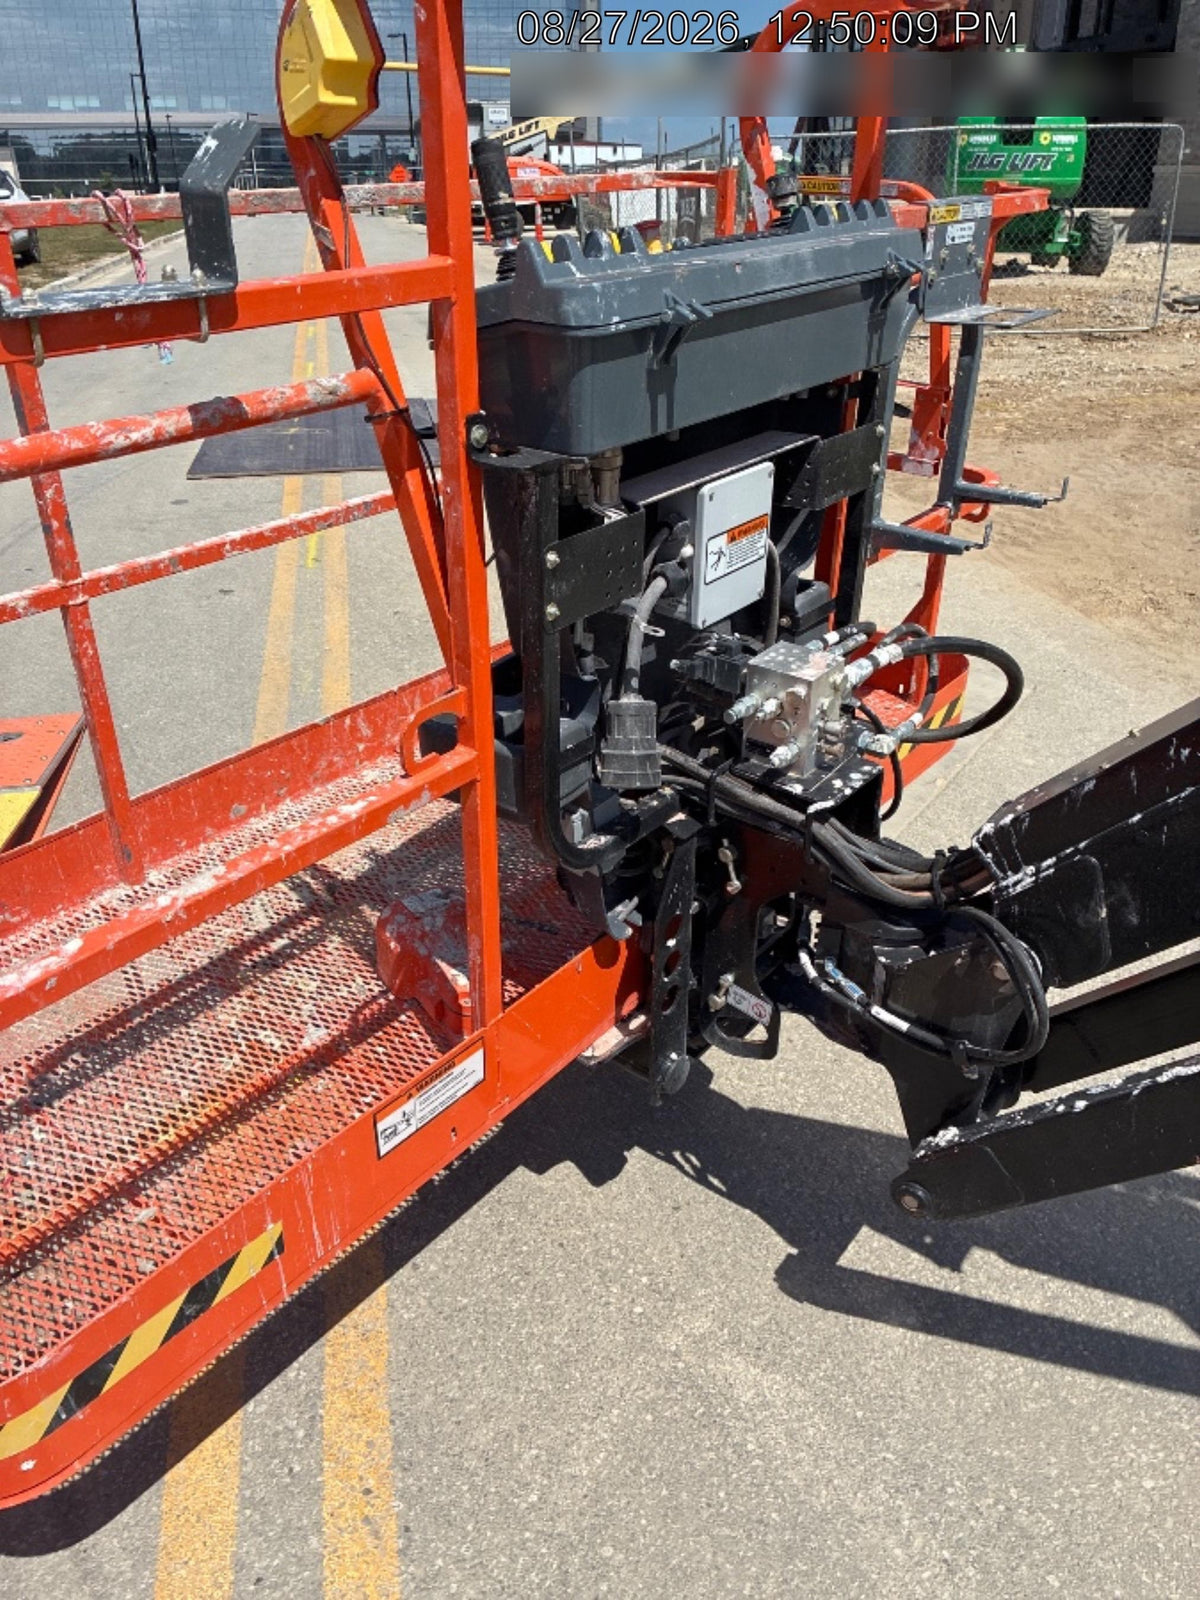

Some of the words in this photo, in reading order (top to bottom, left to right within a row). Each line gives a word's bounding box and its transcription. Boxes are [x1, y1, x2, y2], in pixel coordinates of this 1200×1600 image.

[518, 120, 540, 136] LIFT
[966, 152, 1008, 171] JLG
[1006, 152, 1058, 171] LIFT
